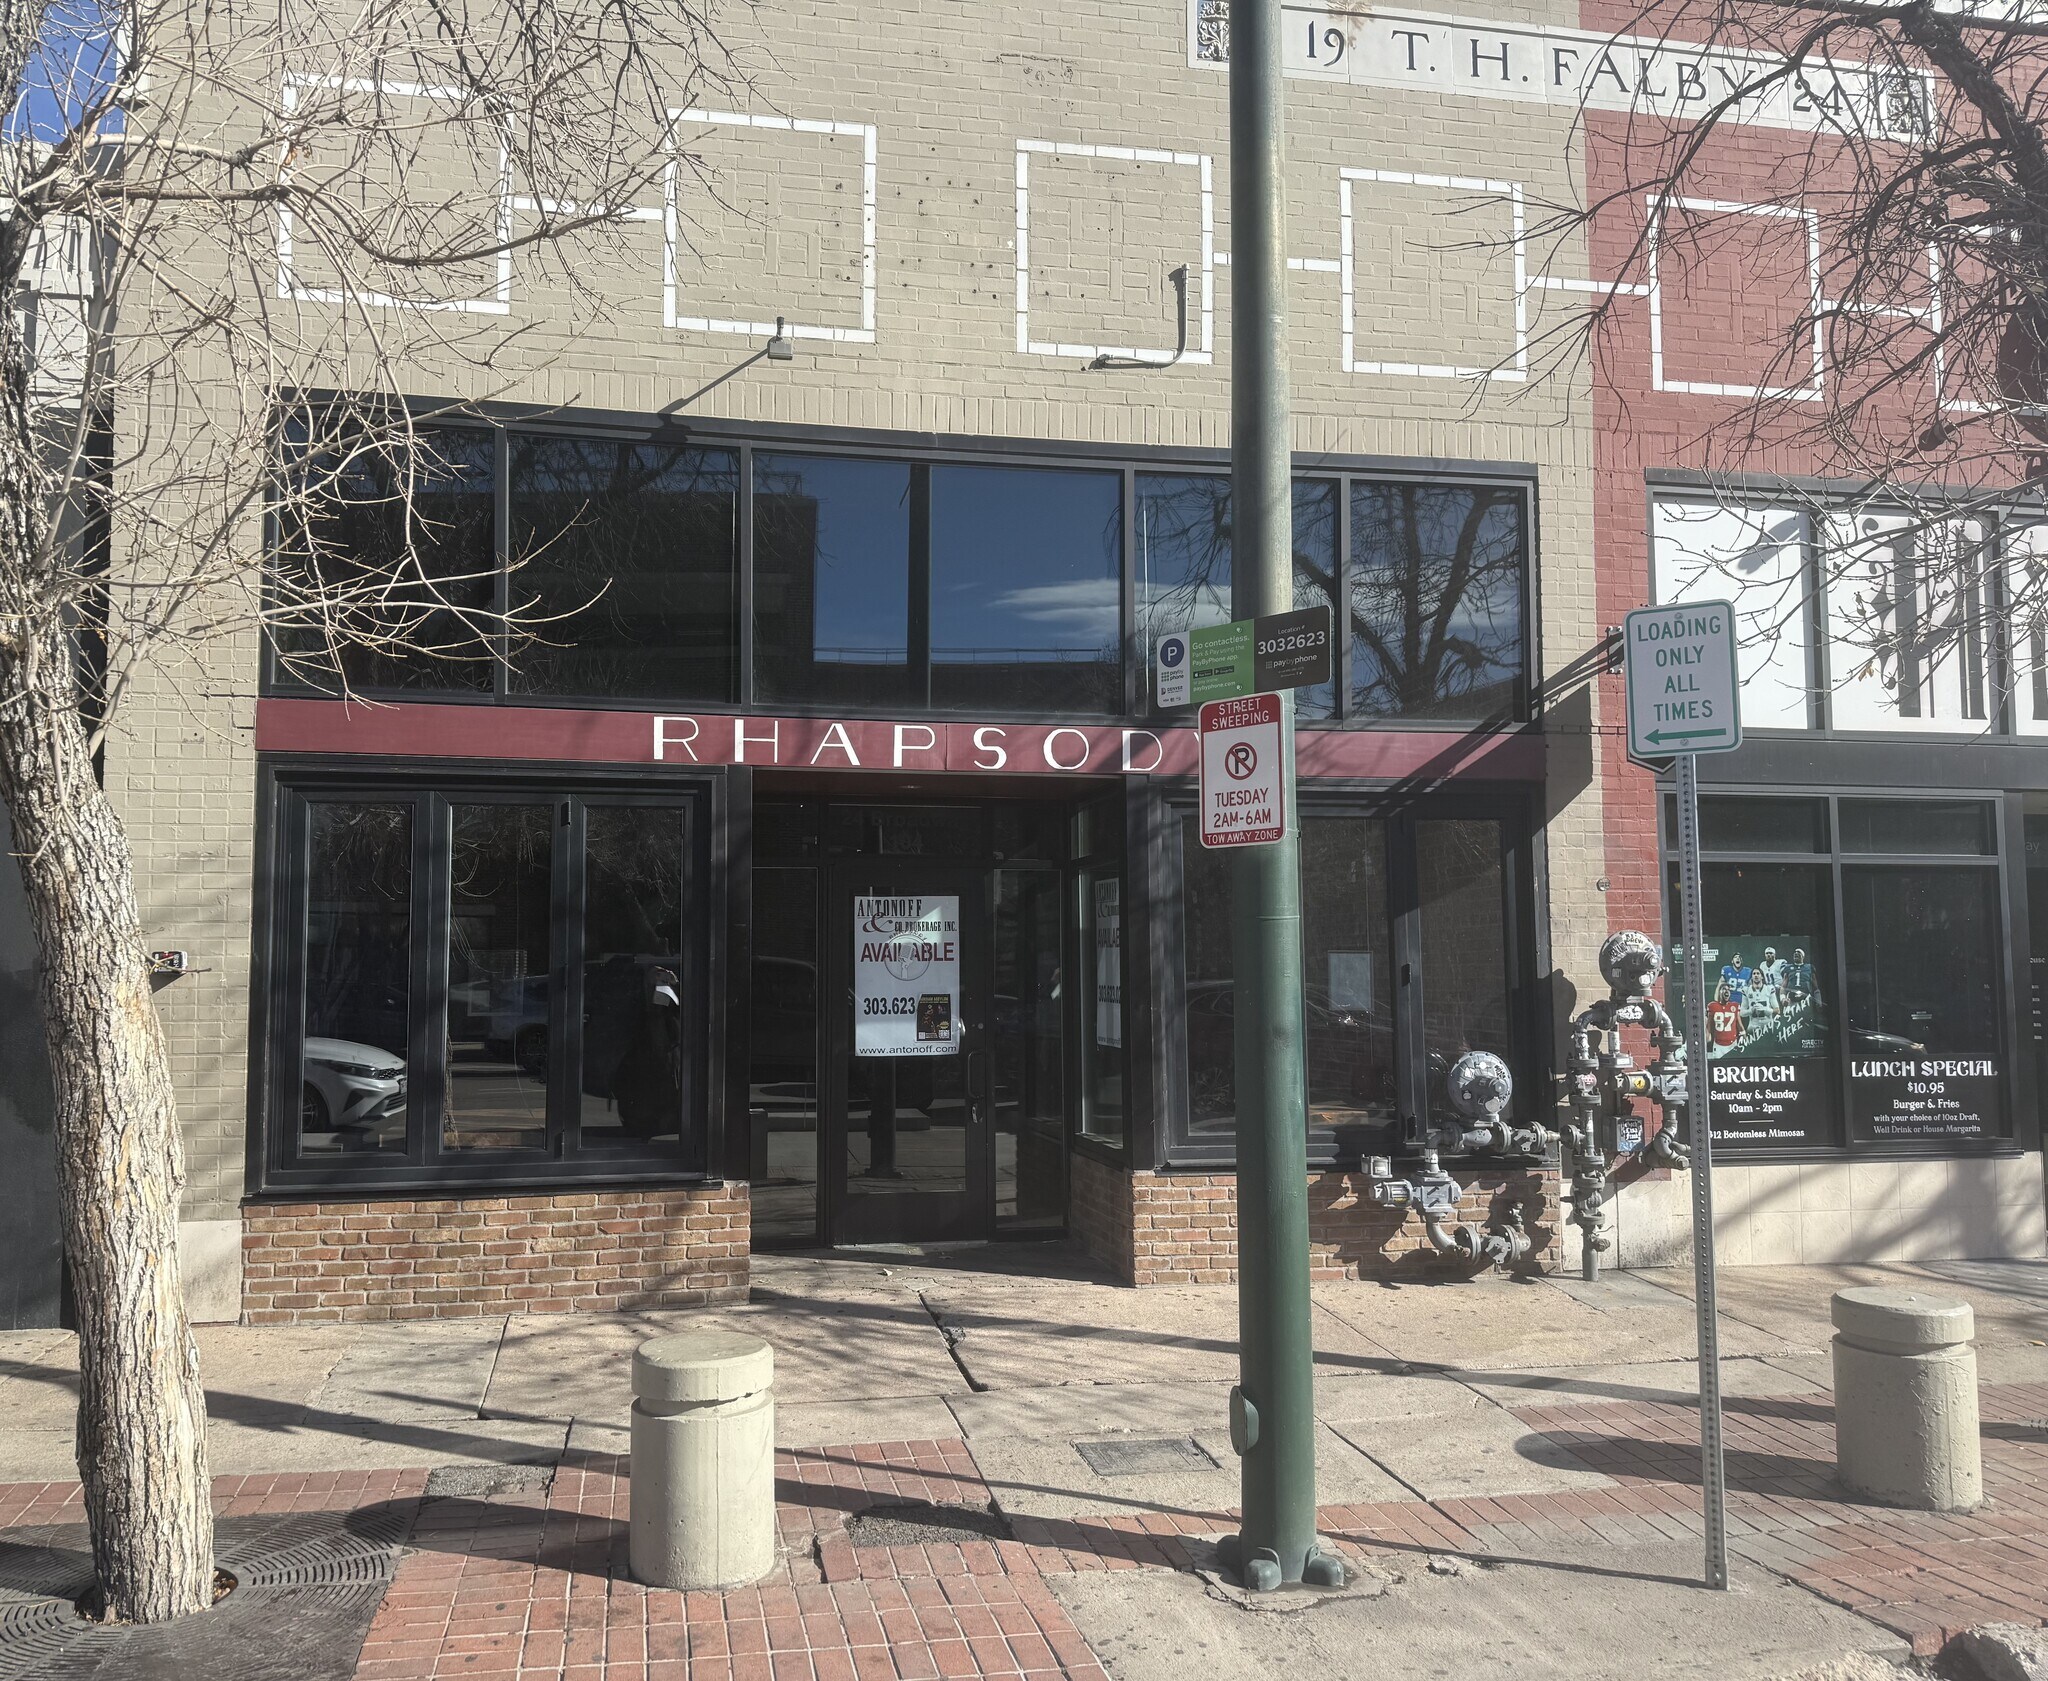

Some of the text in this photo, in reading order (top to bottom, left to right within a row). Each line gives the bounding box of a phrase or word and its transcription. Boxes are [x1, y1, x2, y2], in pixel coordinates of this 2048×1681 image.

[1306, 20, 1844, 117] 19 T. H. FALBY 24
[1277, 626, 1300, 635] Location
[1637, 615, 1721, 642] LOADING
[1192, 635, 1250, 650] Go contactless.
[1258, 631, 1325, 655] 3032623
[1273, 654, 1318, 668] paybyphone
[1655, 645, 1705, 668] ONLY
[1192, 681, 1236, 692] paybyphone.com
[1664, 673, 1700, 694] ALL
[1218, 697, 1262, 715] STREET
[1653, 699, 1713, 722] TIMES
[1211, 710, 1270, 729] SWEEPING
[653, 715, 1199, 772] RHAPSOD
[1214, 787, 1269, 808] TUESDAY
[1213, 808, 1271, 828] 2AM-6AM
[1207, 830, 1279, 845] TOW AWAY ZONE
[857, 898, 923, 917] ANTONOFF
[860, 942, 955, 963] AVAIABLE
[863, 997, 916, 1016] 303.623
[1713, 1011, 1736, 1032] 87
[1736, 993, 1811, 1053] SUNDAYS START
[1777, 1017, 1804, 1043] HERE
[858, 1044, 957, 1055] www.antonoff.com
[1712, 1065, 1795, 1083] BRUNCH
[1851, 1060, 1998, 1078] LUNCH SPECIAL
[1710, 1089, 1799, 1102] Saturday & Sunday
[1907, 1081, 1945, 1094] $10.95
[1728, 1104, 1753, 1114] 10am
[1762, 1103, 1783, 1114] 2pm
[1893, 1098, 1960, 1111] Burger & Fries
[1873, 1114, 1889, 1122] with
[1891, 1115, 1908, 1124] your
[1909, 1113, 1933, 1122] choice
[1933, 1113, 1940, 1121] of
[1941, 1113, 1958, 1121] 10oz
[1723, 1130, 1766, 1139] Bottomless
[1768, 1129, 1805, 1138] Mimosas
[1873, 1125, 1981, 1134] Well Drink or House Margarita
